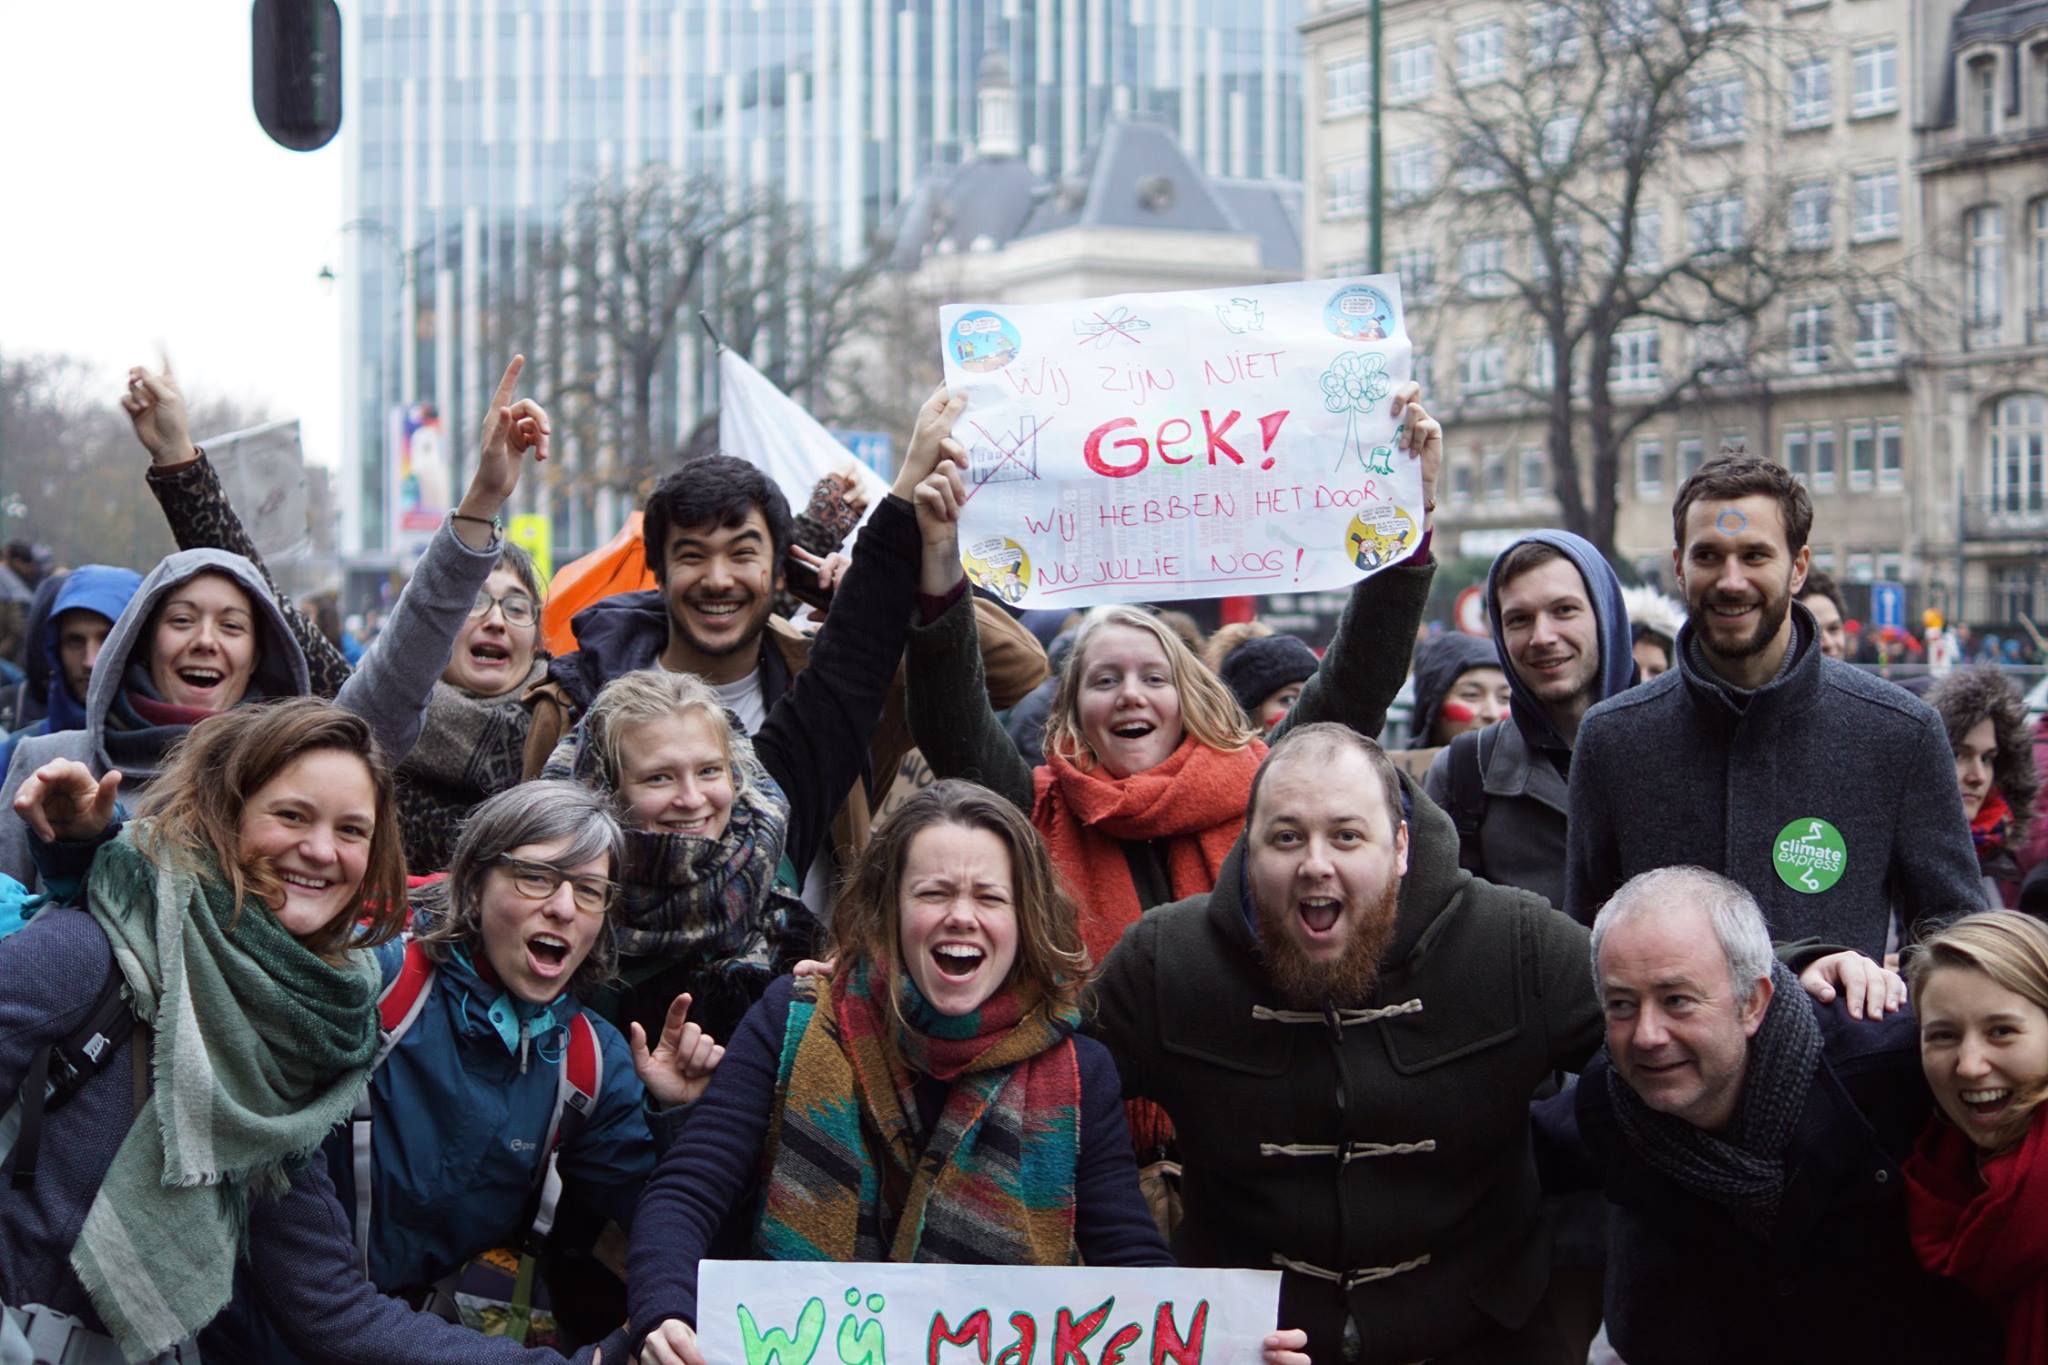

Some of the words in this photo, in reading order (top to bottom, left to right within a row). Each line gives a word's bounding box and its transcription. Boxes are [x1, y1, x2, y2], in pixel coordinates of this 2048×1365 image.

[1098, 491, 1236, 528] HEBBEN
[1255, 486, 1304, 516] HET
[1038, 561, 1079, 587] NU
[1777, 851, 1840, 872] express
[1779, 838, 1841, 861] climate
